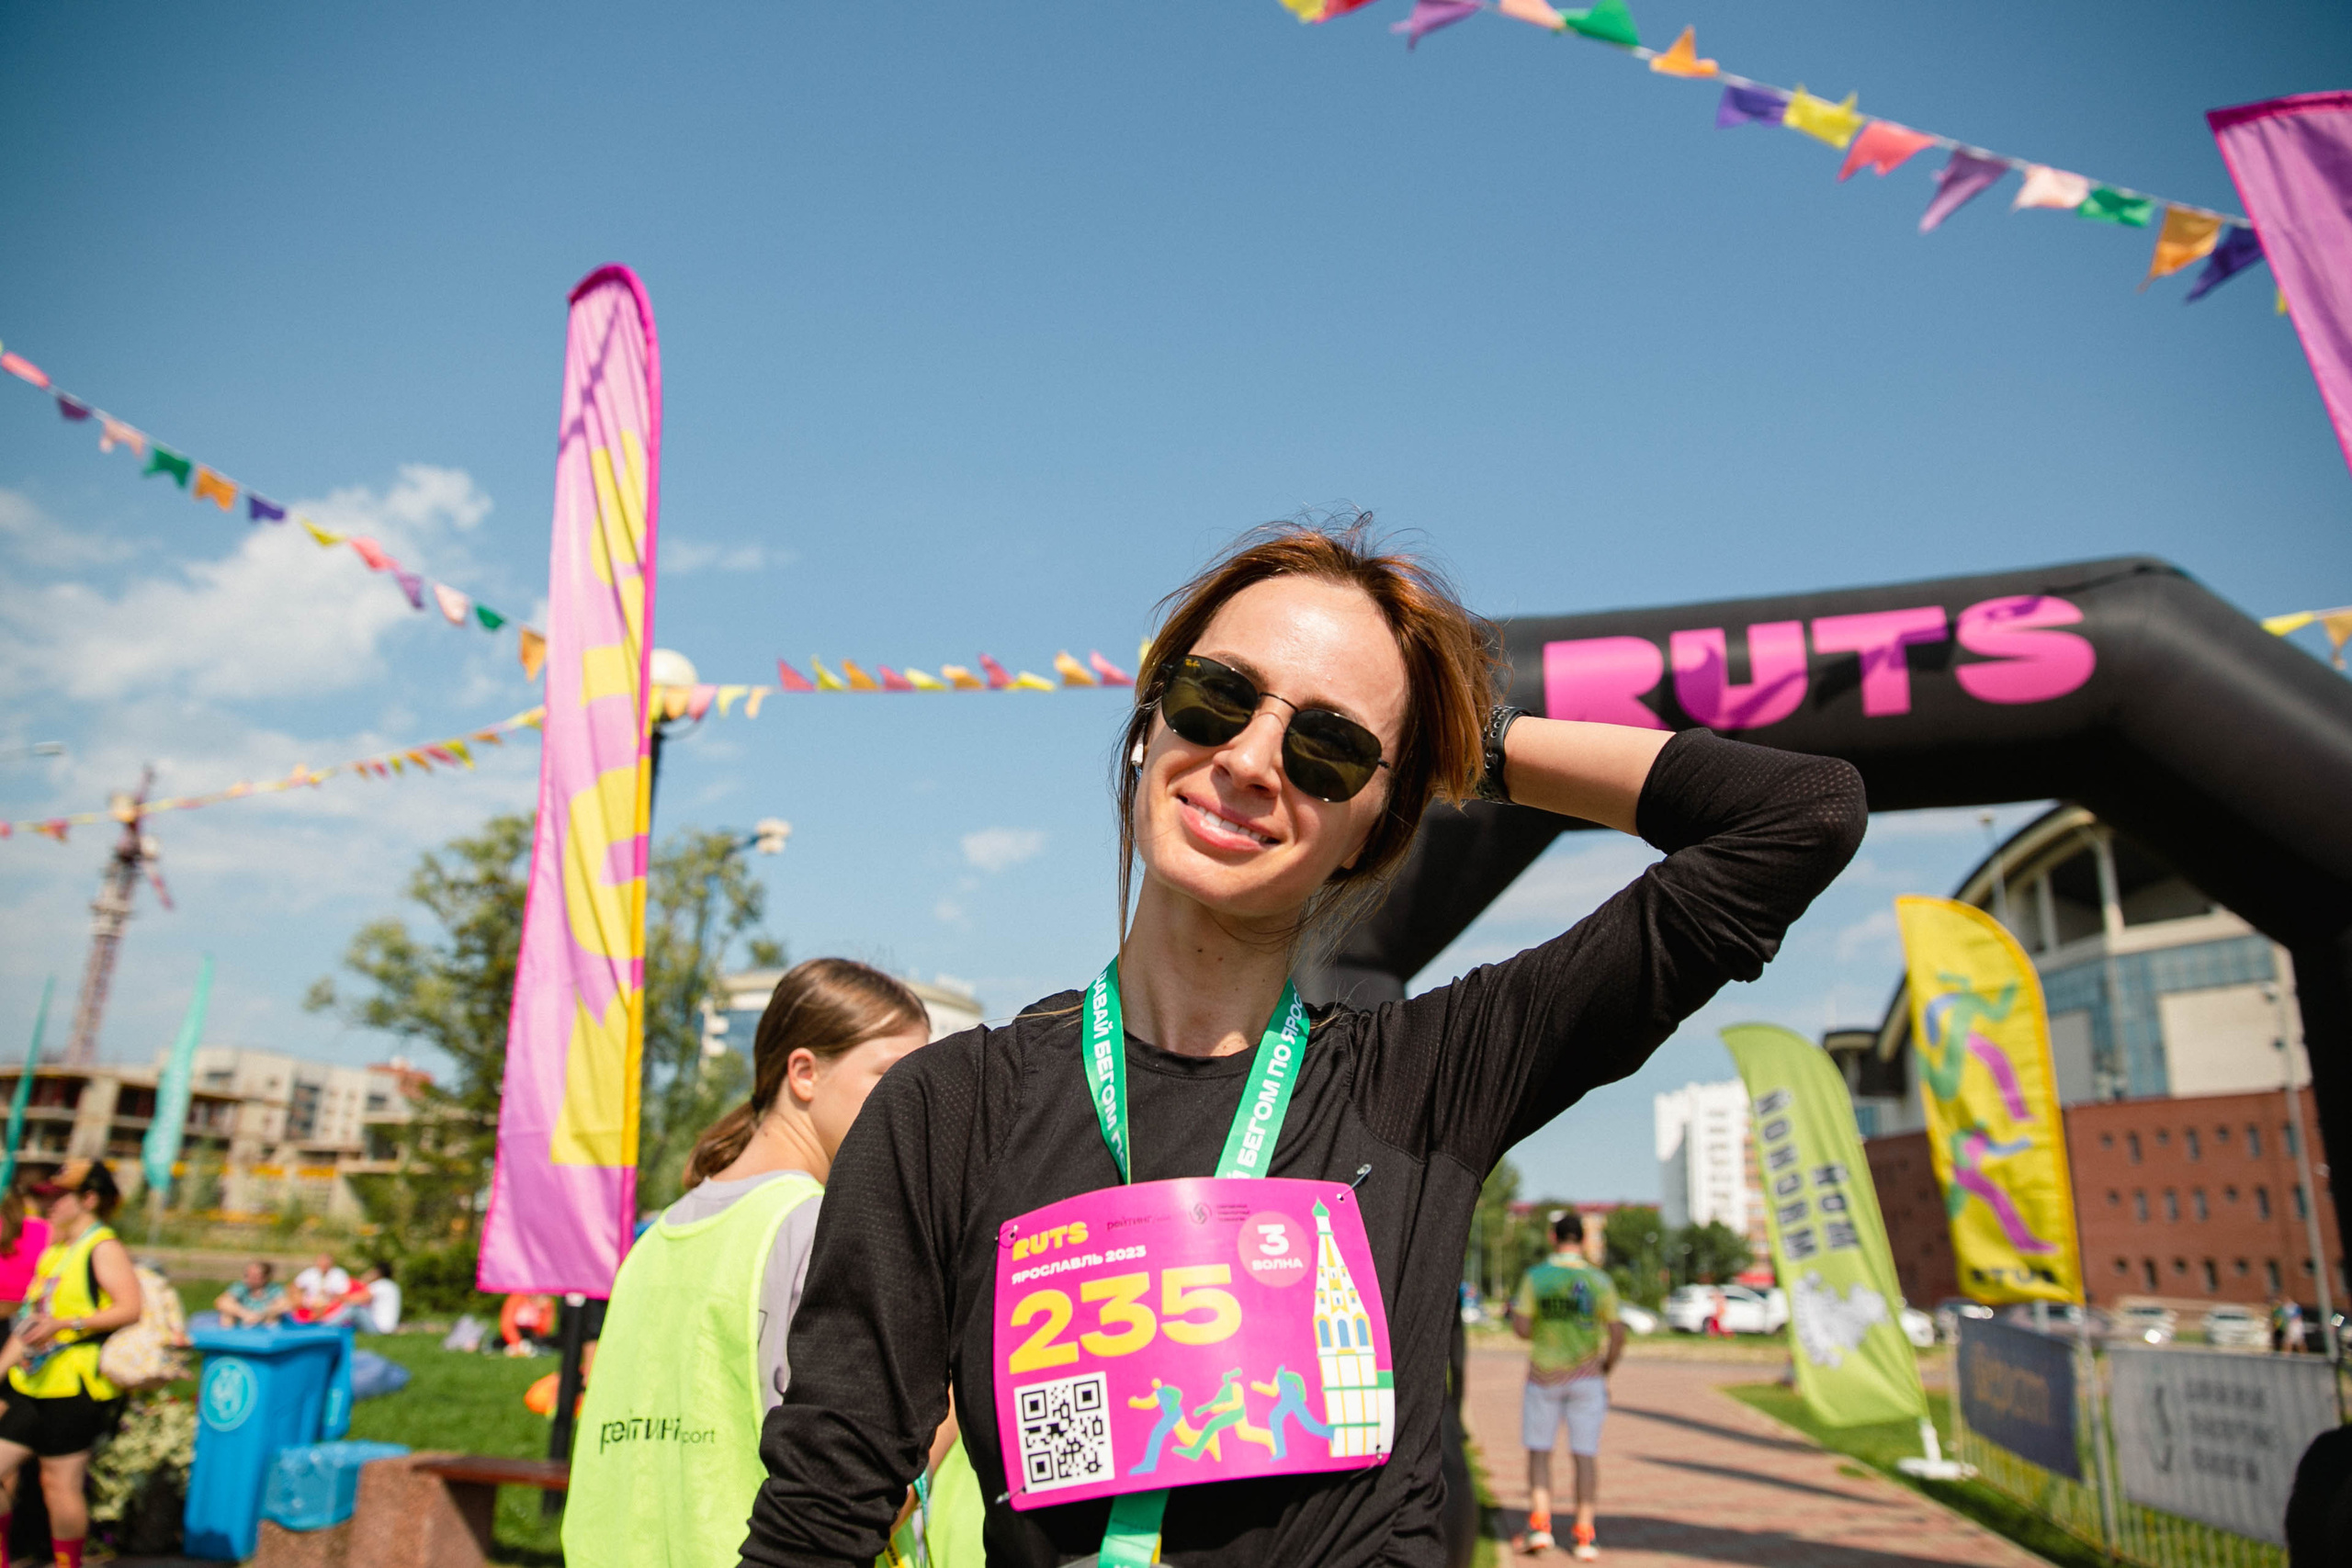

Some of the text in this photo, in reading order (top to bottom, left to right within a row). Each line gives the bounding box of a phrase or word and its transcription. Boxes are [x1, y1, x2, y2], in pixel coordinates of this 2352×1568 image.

[1544, 595, 2097, 731] RUTS
[1093, 1040, 1116, 1131] БЕГОМ
[1237, 1079, 1281, 1168] БЕГОМ
[1267, 1043, 1292, 1077] ПО
[1281, 986, 1303, 1045] ЯРОС
[1012, 1221, 1089, 1261] RUTS
[1012, 1244, 1147, 1285] ЯРОСЛАВЛЬ 2023
[1251, 1257, 1304, 1271] ВОЛНА
[1257, 1224, 1290, 1257] 3
[1009, 1264, 1242, 1375] 235
